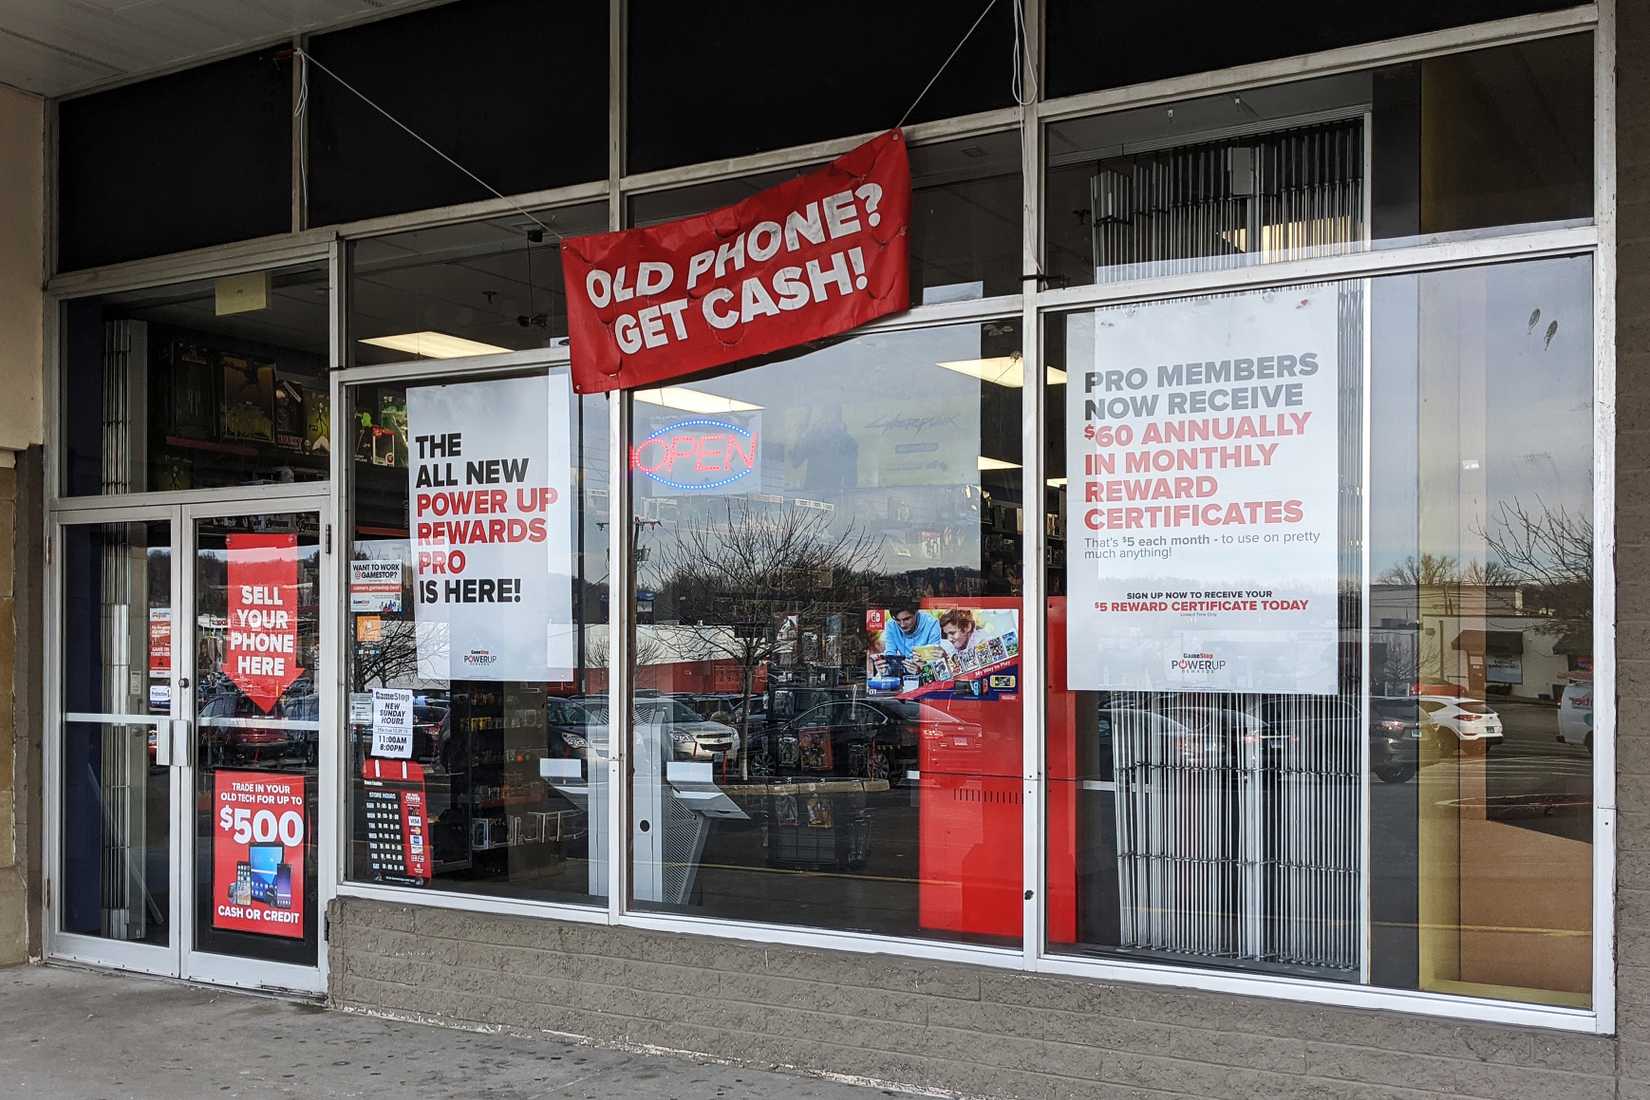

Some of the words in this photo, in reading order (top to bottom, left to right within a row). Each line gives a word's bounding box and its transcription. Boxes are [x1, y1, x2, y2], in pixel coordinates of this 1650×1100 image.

[586, 262, 674, 308] OLD
[687, 183, 883, 289] PHONE?
[614, 299, 688, 355] GET
[702, 247, 868, 329] CASH!
[1084, 368, 1148, 393] PRO
[1156, 353, 1319, 388] MEMBERS
[1084, 394, 1160, 421] NOW
[1168, 383, 1303, 416] RECEIVE
[1084, 424, 1133, 447] $60
[1141, 411, 1312, 445] ANNUALLY
[416, 433, 462, 459] THE
[631, 432, 758, 474] OPEN
[1085, 454, 1116, 476] IN
[1125, 443, 1280, 474] MONTHLY
[416, 463, 458, 488] ALL
[466, 458, 529, 485] NEW
[1085, 475, 1218, 503] REWARD
[417, 489, 507, 517] POWER
[517, 487, 558, 513] UP
[1084, 499, 1304, 531] CERTIFICATES
[417, 518, 547, 546] REWARDS
[1084, 537, 1119, 549] That's
[1122, 536, 1135, 548] $5
[1138, 535, 1168, 547] each
[1170, 533, 1210, 546] month
[1221, 533, 1234, 544] to
[1237, 534, 1260, 544] use
[1263, 533, 1280, 543] on
[1283, 531, 1320, 546] pretty
[418, 550, 466, 575] PRO
[1084, 547, 1116, 559] much
[1119, 546, 1172, 560] anything!
[241, 586, 283, 606] SELL
[419, 580, 438, 604] IS
[444, 578, 521, 603] HERE!
[1126, 592, 1148, 600] SIGN
[1189, 591, 1202, 599] TO
[1204, 591, 1243, 599] RECEIVE
[1245, 590, 1273, 598] YOUR
[1095, 601, 1108, 612] $5
[1111, 601, 1168, 612] REWARD
[1171, 600, 1257, 612] CERTIFICATE
[1261, 599, 1309, 611] TODAY
[236, 609, 288, 630] YOUR
[230, 632, 294, 653] PHONE
[237, 656, 285, 676] HERE
[464, 655, 497, 663] POWERUP
[1171, 660, 1226, 670] POWERUP
[376, 691, 410, 702] GameStop
[379, 735, 407, 743] 11:00AM
[221, 792, 237, 801] OLD
[238, 793, 256, 802] TECH
[257, 795, 275, 804] FOR
[277, 796, 290, 805] UP
[291, 797, 302, 805] TO
[232, 782, 254, 792] TRADE
[255, 783, 264, 793] IN
[266, 784, 290, 794] YOUR
[220, 805, 304, 847] $500
[218, 905, 244, 919] CASH
[246, 909, 261, 920] OR
[263, 910, 300, 923] CREDIT
